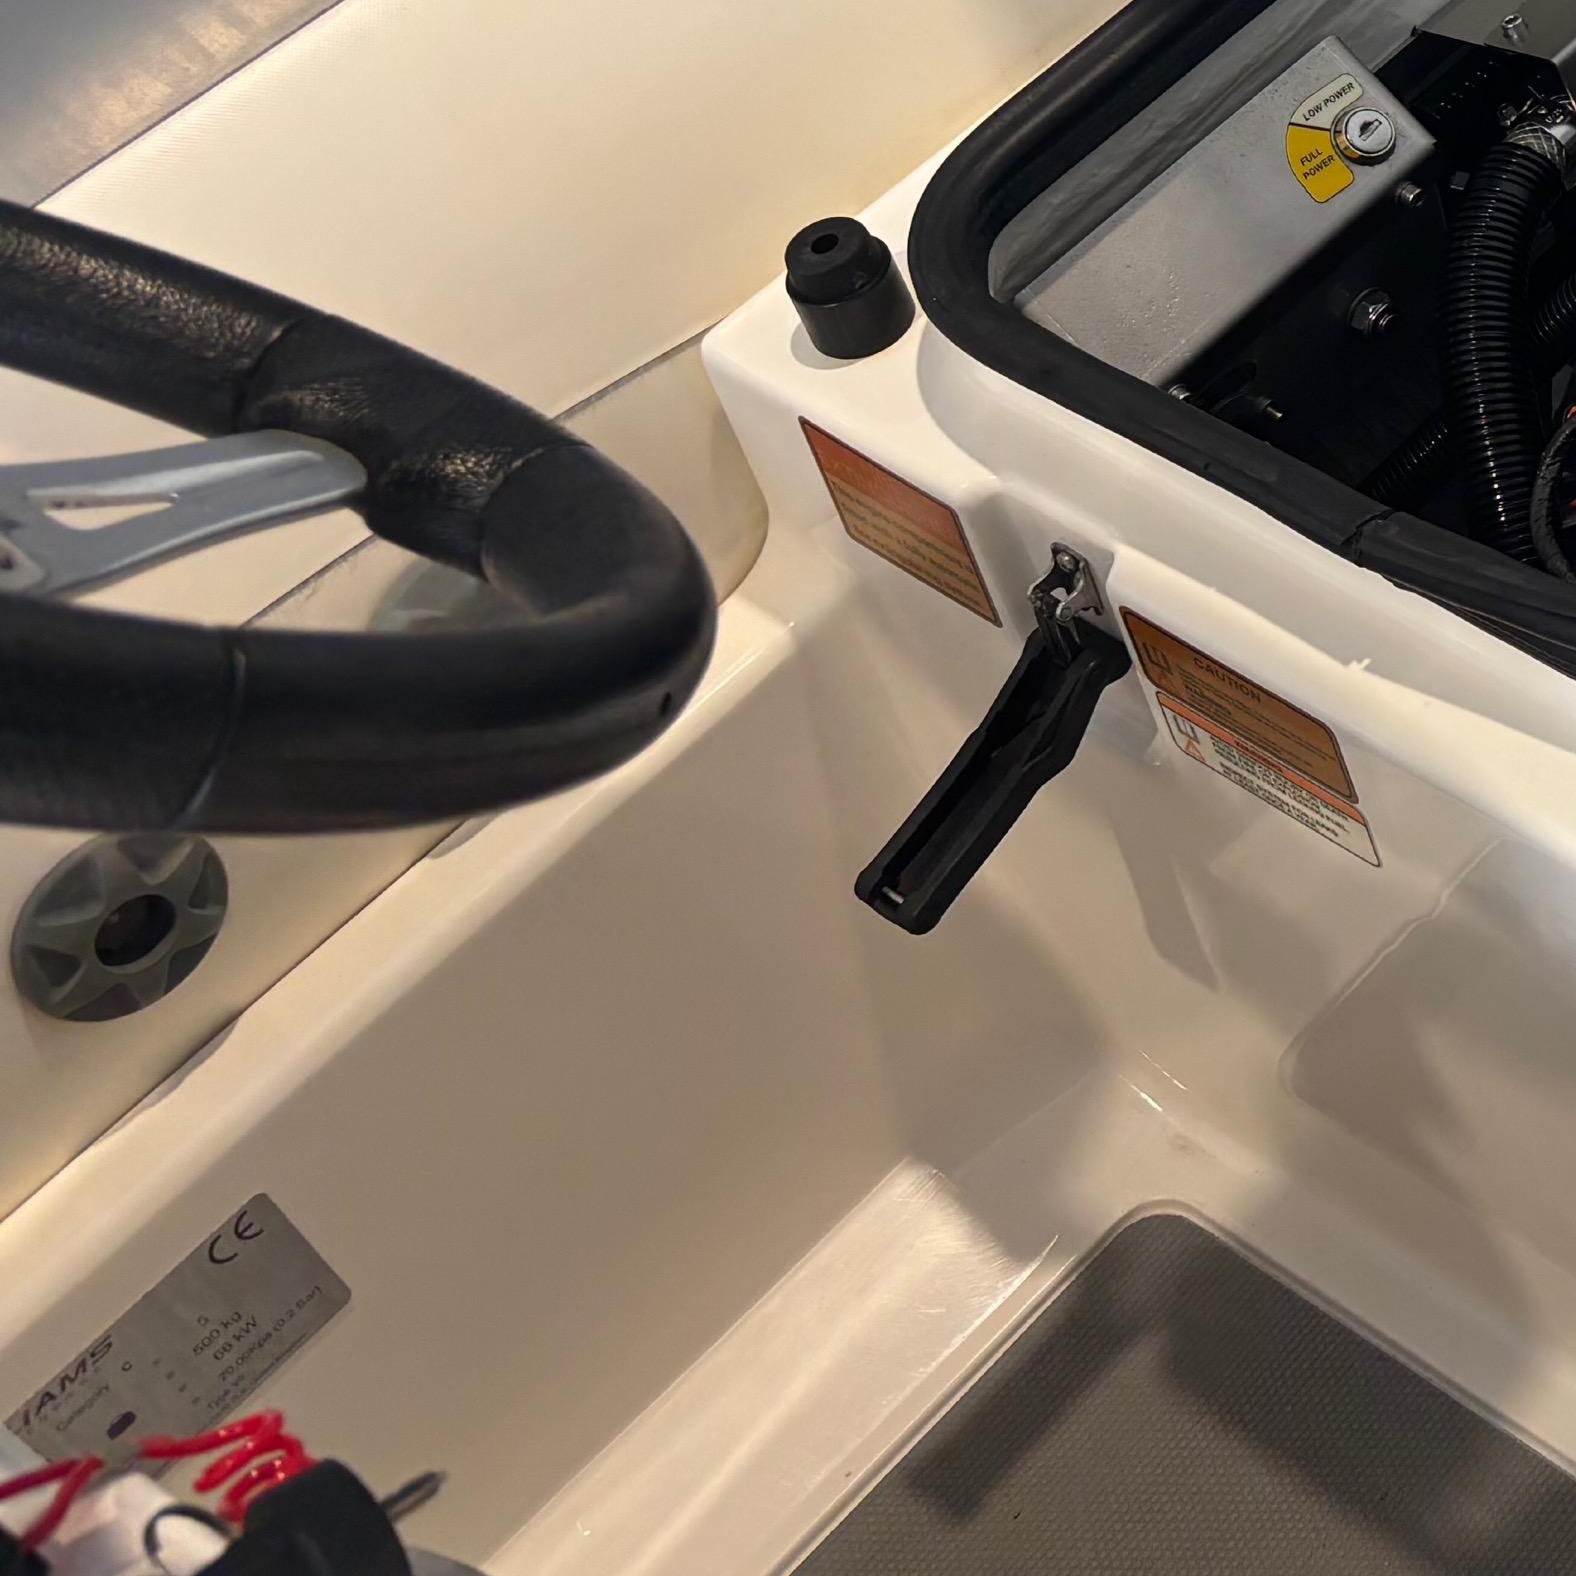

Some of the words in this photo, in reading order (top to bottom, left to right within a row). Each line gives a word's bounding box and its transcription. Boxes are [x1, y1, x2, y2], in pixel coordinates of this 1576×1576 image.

[1302, 102, 1323, 122] LOW
[1323, 82, 1356, 107] POWER
[1300, 148, 1324, 167] FULL
[1303, 154, 1336, 180] POWER
[1192, 656, 1262, 704] CAUTION
[208, 1210, 265, 1265] CE
